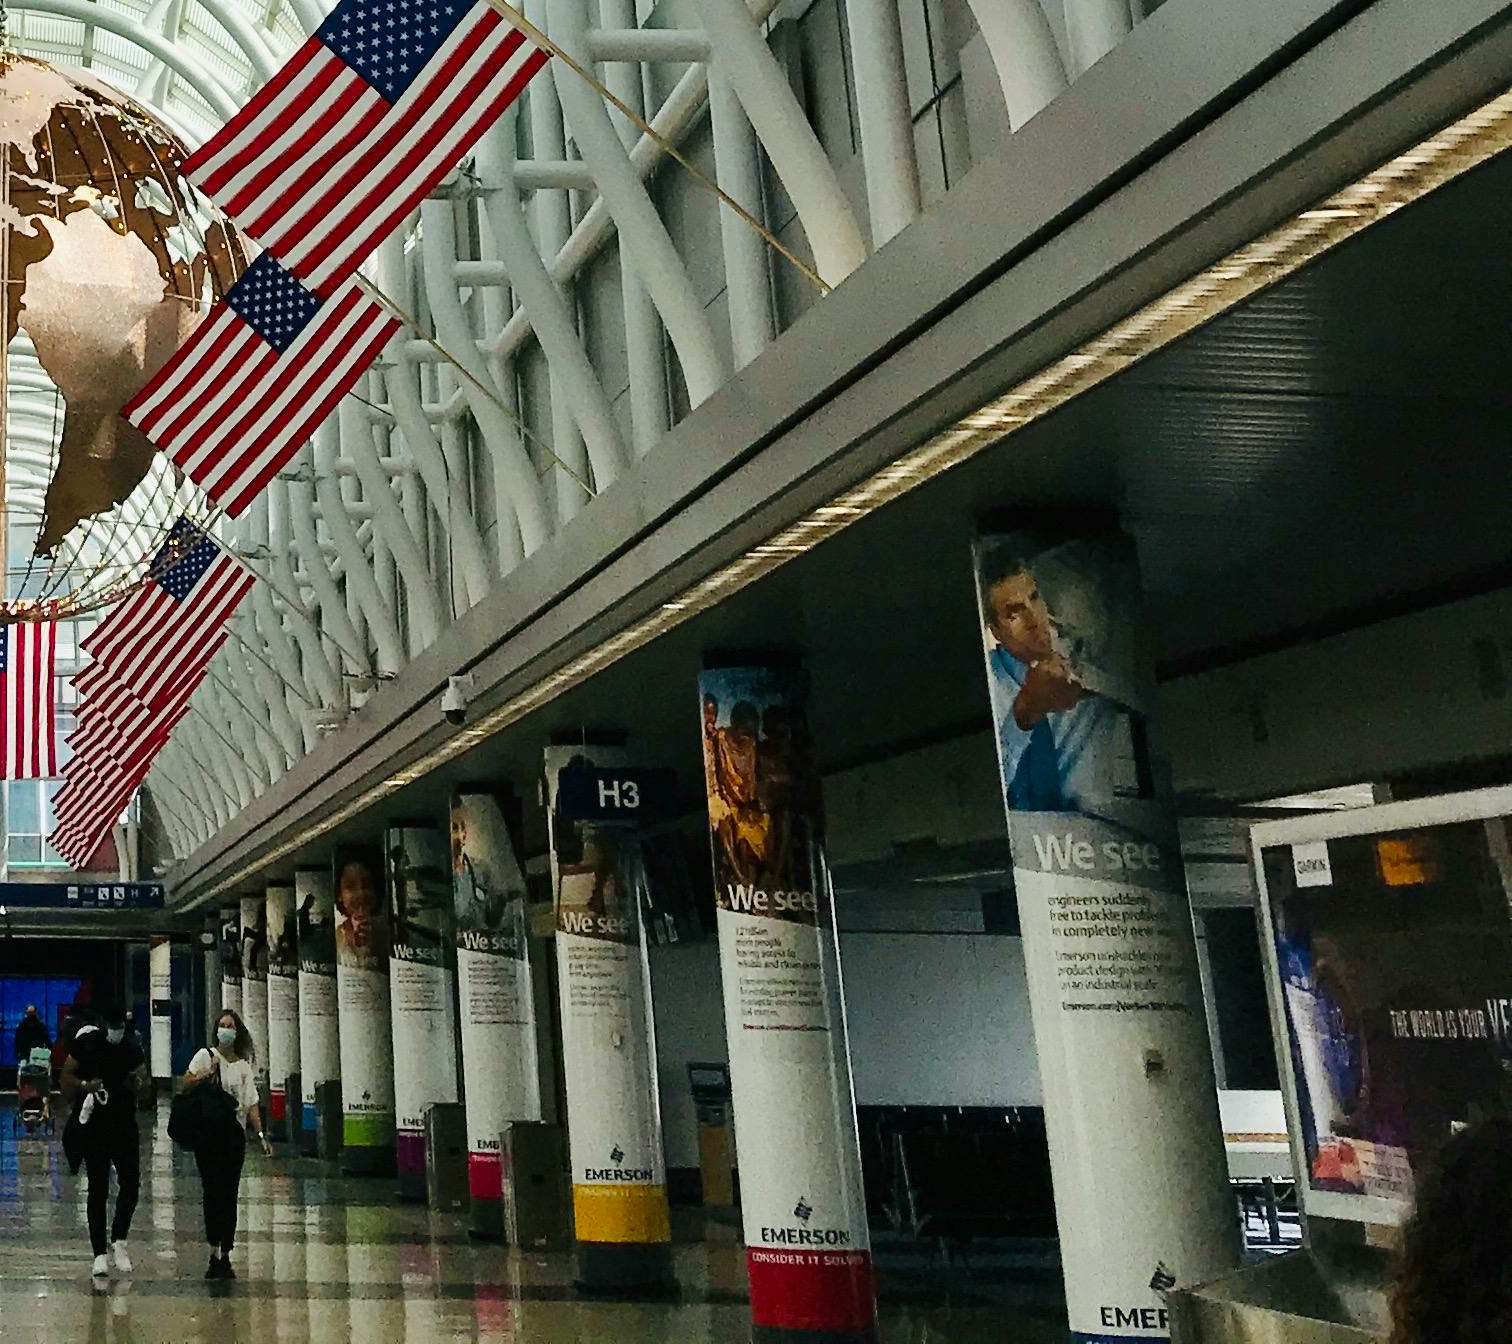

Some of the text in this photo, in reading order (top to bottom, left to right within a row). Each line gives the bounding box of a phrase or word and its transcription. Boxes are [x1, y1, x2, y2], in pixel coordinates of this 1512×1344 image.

[598, 779, 640, 808] H3
[1033, 832, 1161, 871] We see
[727, 883, 816, 912] We see
[1048, 895, 1100, 909] engineers
[562, 912, 629, 934] We see
[1050, 910, 1070, 921] free
[1070, 911, 1084, 921] to
[1084, 908, 1122, 922] tackle
[1063, 923, 1128, 939] completely
[463, 932, 518, 950] We see
[394, 944, 414, 959] We
[1389, 1010, 1410, 1038] THE
[1410, 1010, 1445, 1038] WORLD
[1445, 1010, 1457, 1038] IS
[1458, 1009, 1488, 1038] YOUR
[585, 1169, 653, 1181] EMERSON
[761, 1227, 851, 1245] EMERSON
[752, 1252, 805, 1265] CONSIDER
[808, 1255, 819, 1265] IT
